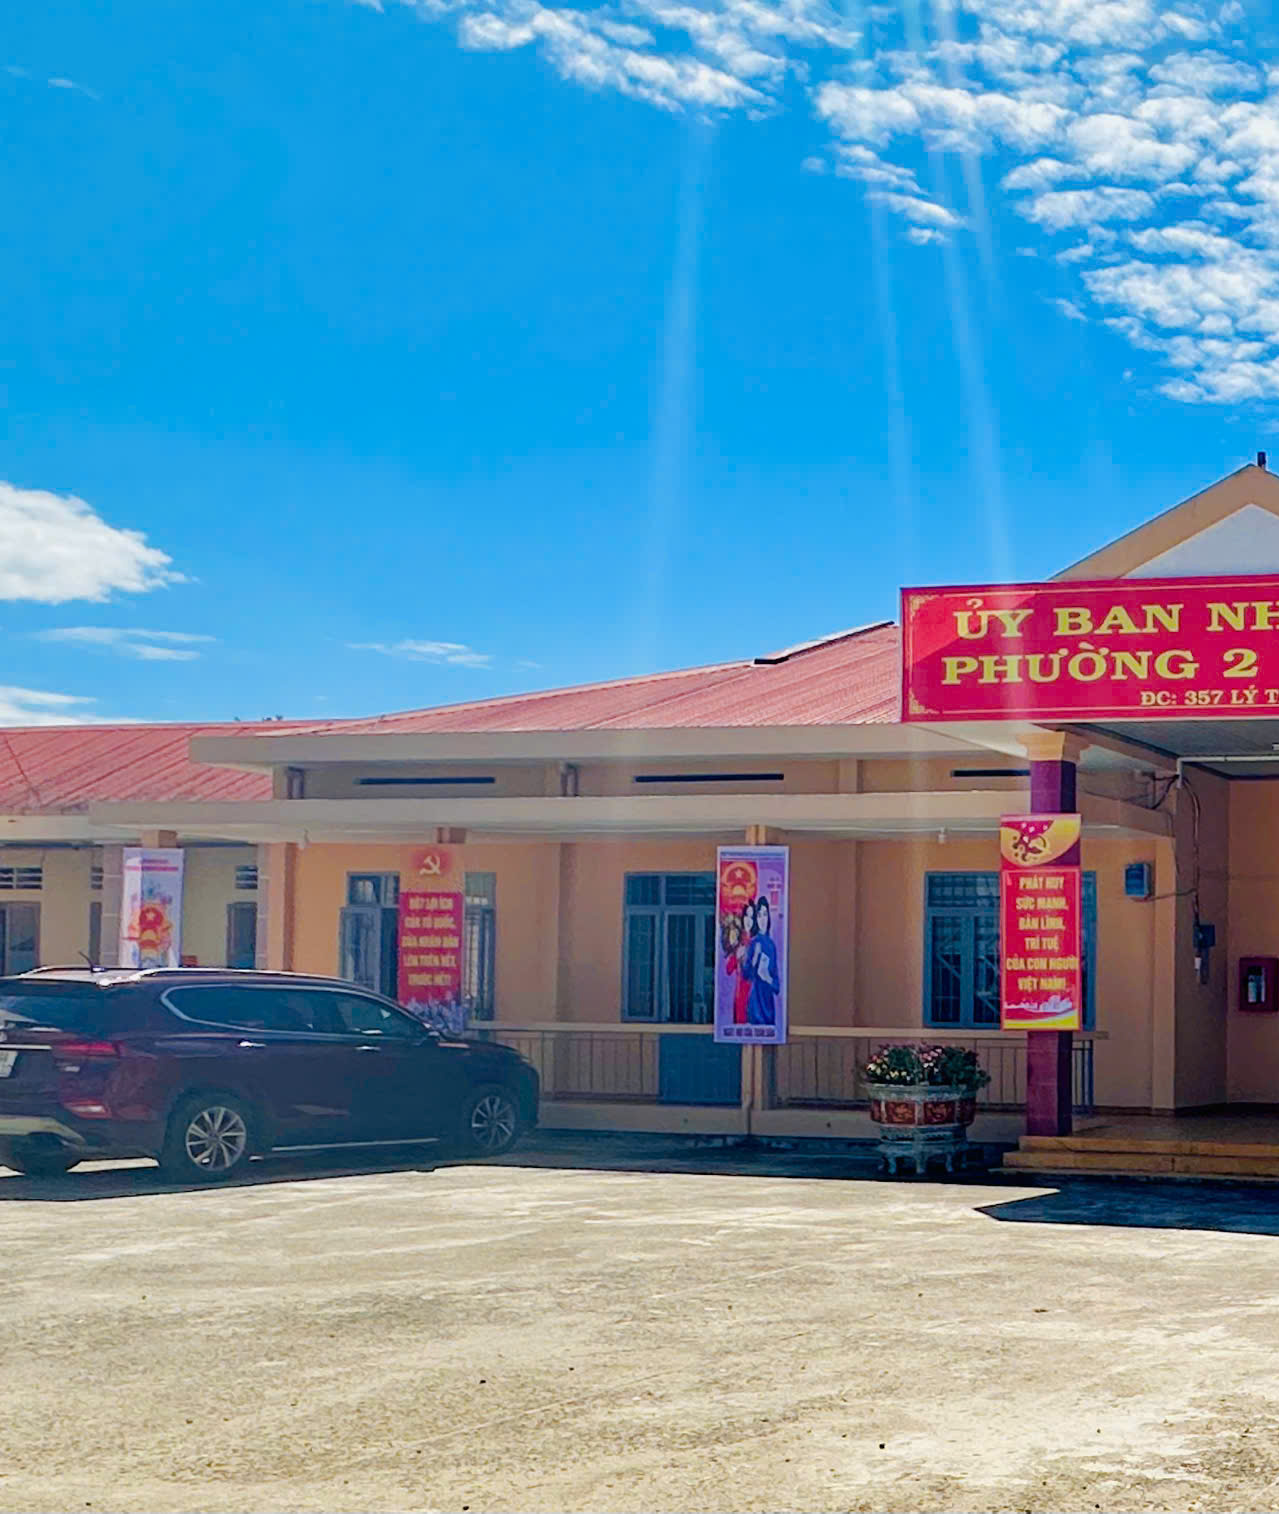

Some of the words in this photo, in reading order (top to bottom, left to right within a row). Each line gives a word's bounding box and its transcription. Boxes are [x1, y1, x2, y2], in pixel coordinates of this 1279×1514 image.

[953, 598, 1034, 640] ỦY
[1053, 604, 1184, 636] BAN
[941, 641, 1199, 685] PHƯỜNG
[1223, 648, 1258, 678] 2
[1141, 690, 1177, 706] ĐC:
[1184, 689, 1224, 705] 357
[1230, 684, 1258, 704] LÝ
